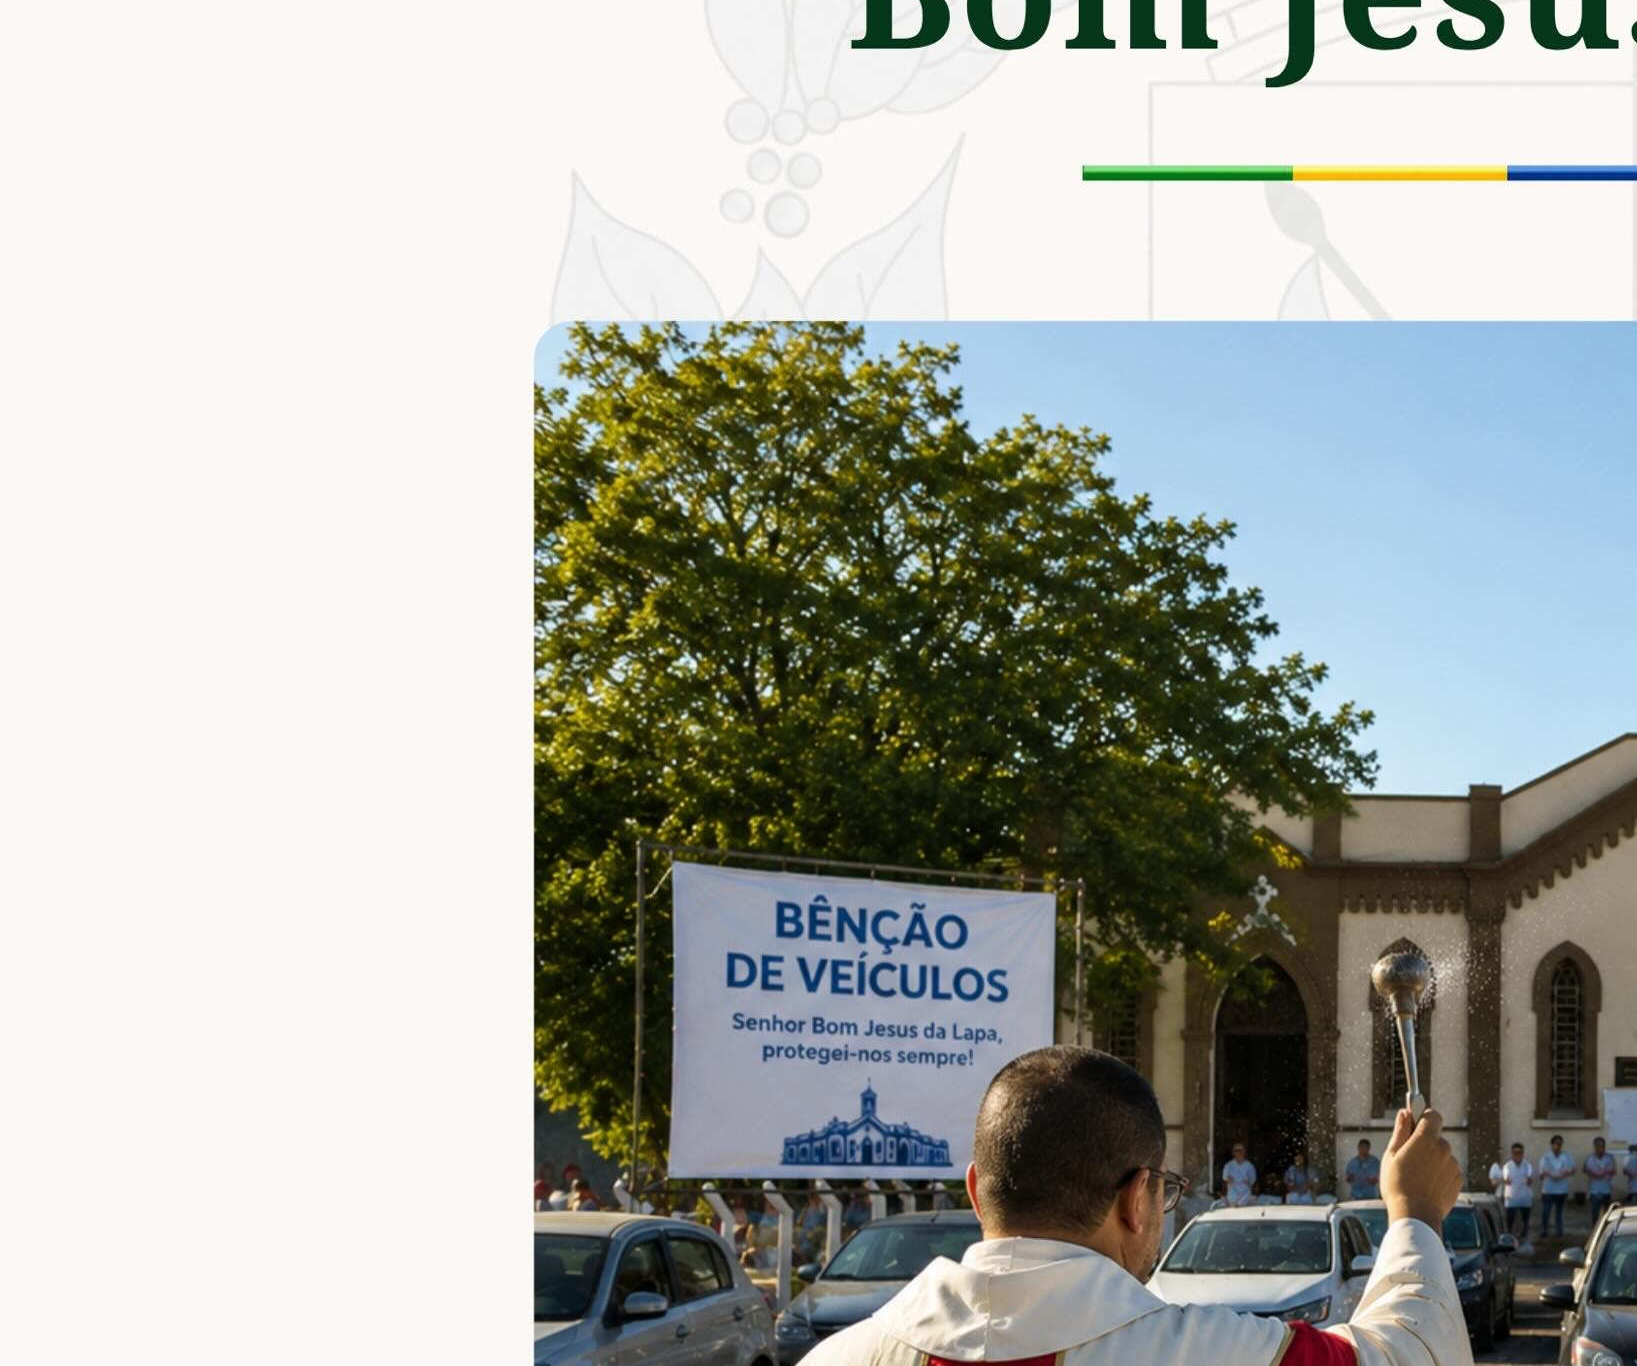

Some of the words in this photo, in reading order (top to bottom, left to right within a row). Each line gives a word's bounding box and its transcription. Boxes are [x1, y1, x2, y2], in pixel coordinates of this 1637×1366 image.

[775, 894, 968, 954] BÊNÇÃO
[725, 952, 785, 992] DE
[796, 951, 1009, 1003] VEÍCULOS
[732, 1013, 805, 1034] Senhor
[812, 1016, 858, 1036] Bom
[863, 1019, 918, 1039] Jesus
[923, 1022, 947, 1040] da
[952, 1023, 1003, 1045] Lapa,
[762, 1043, 891, 1065] protegei-nos
[897, 1049, 974, 1068] sempre!
